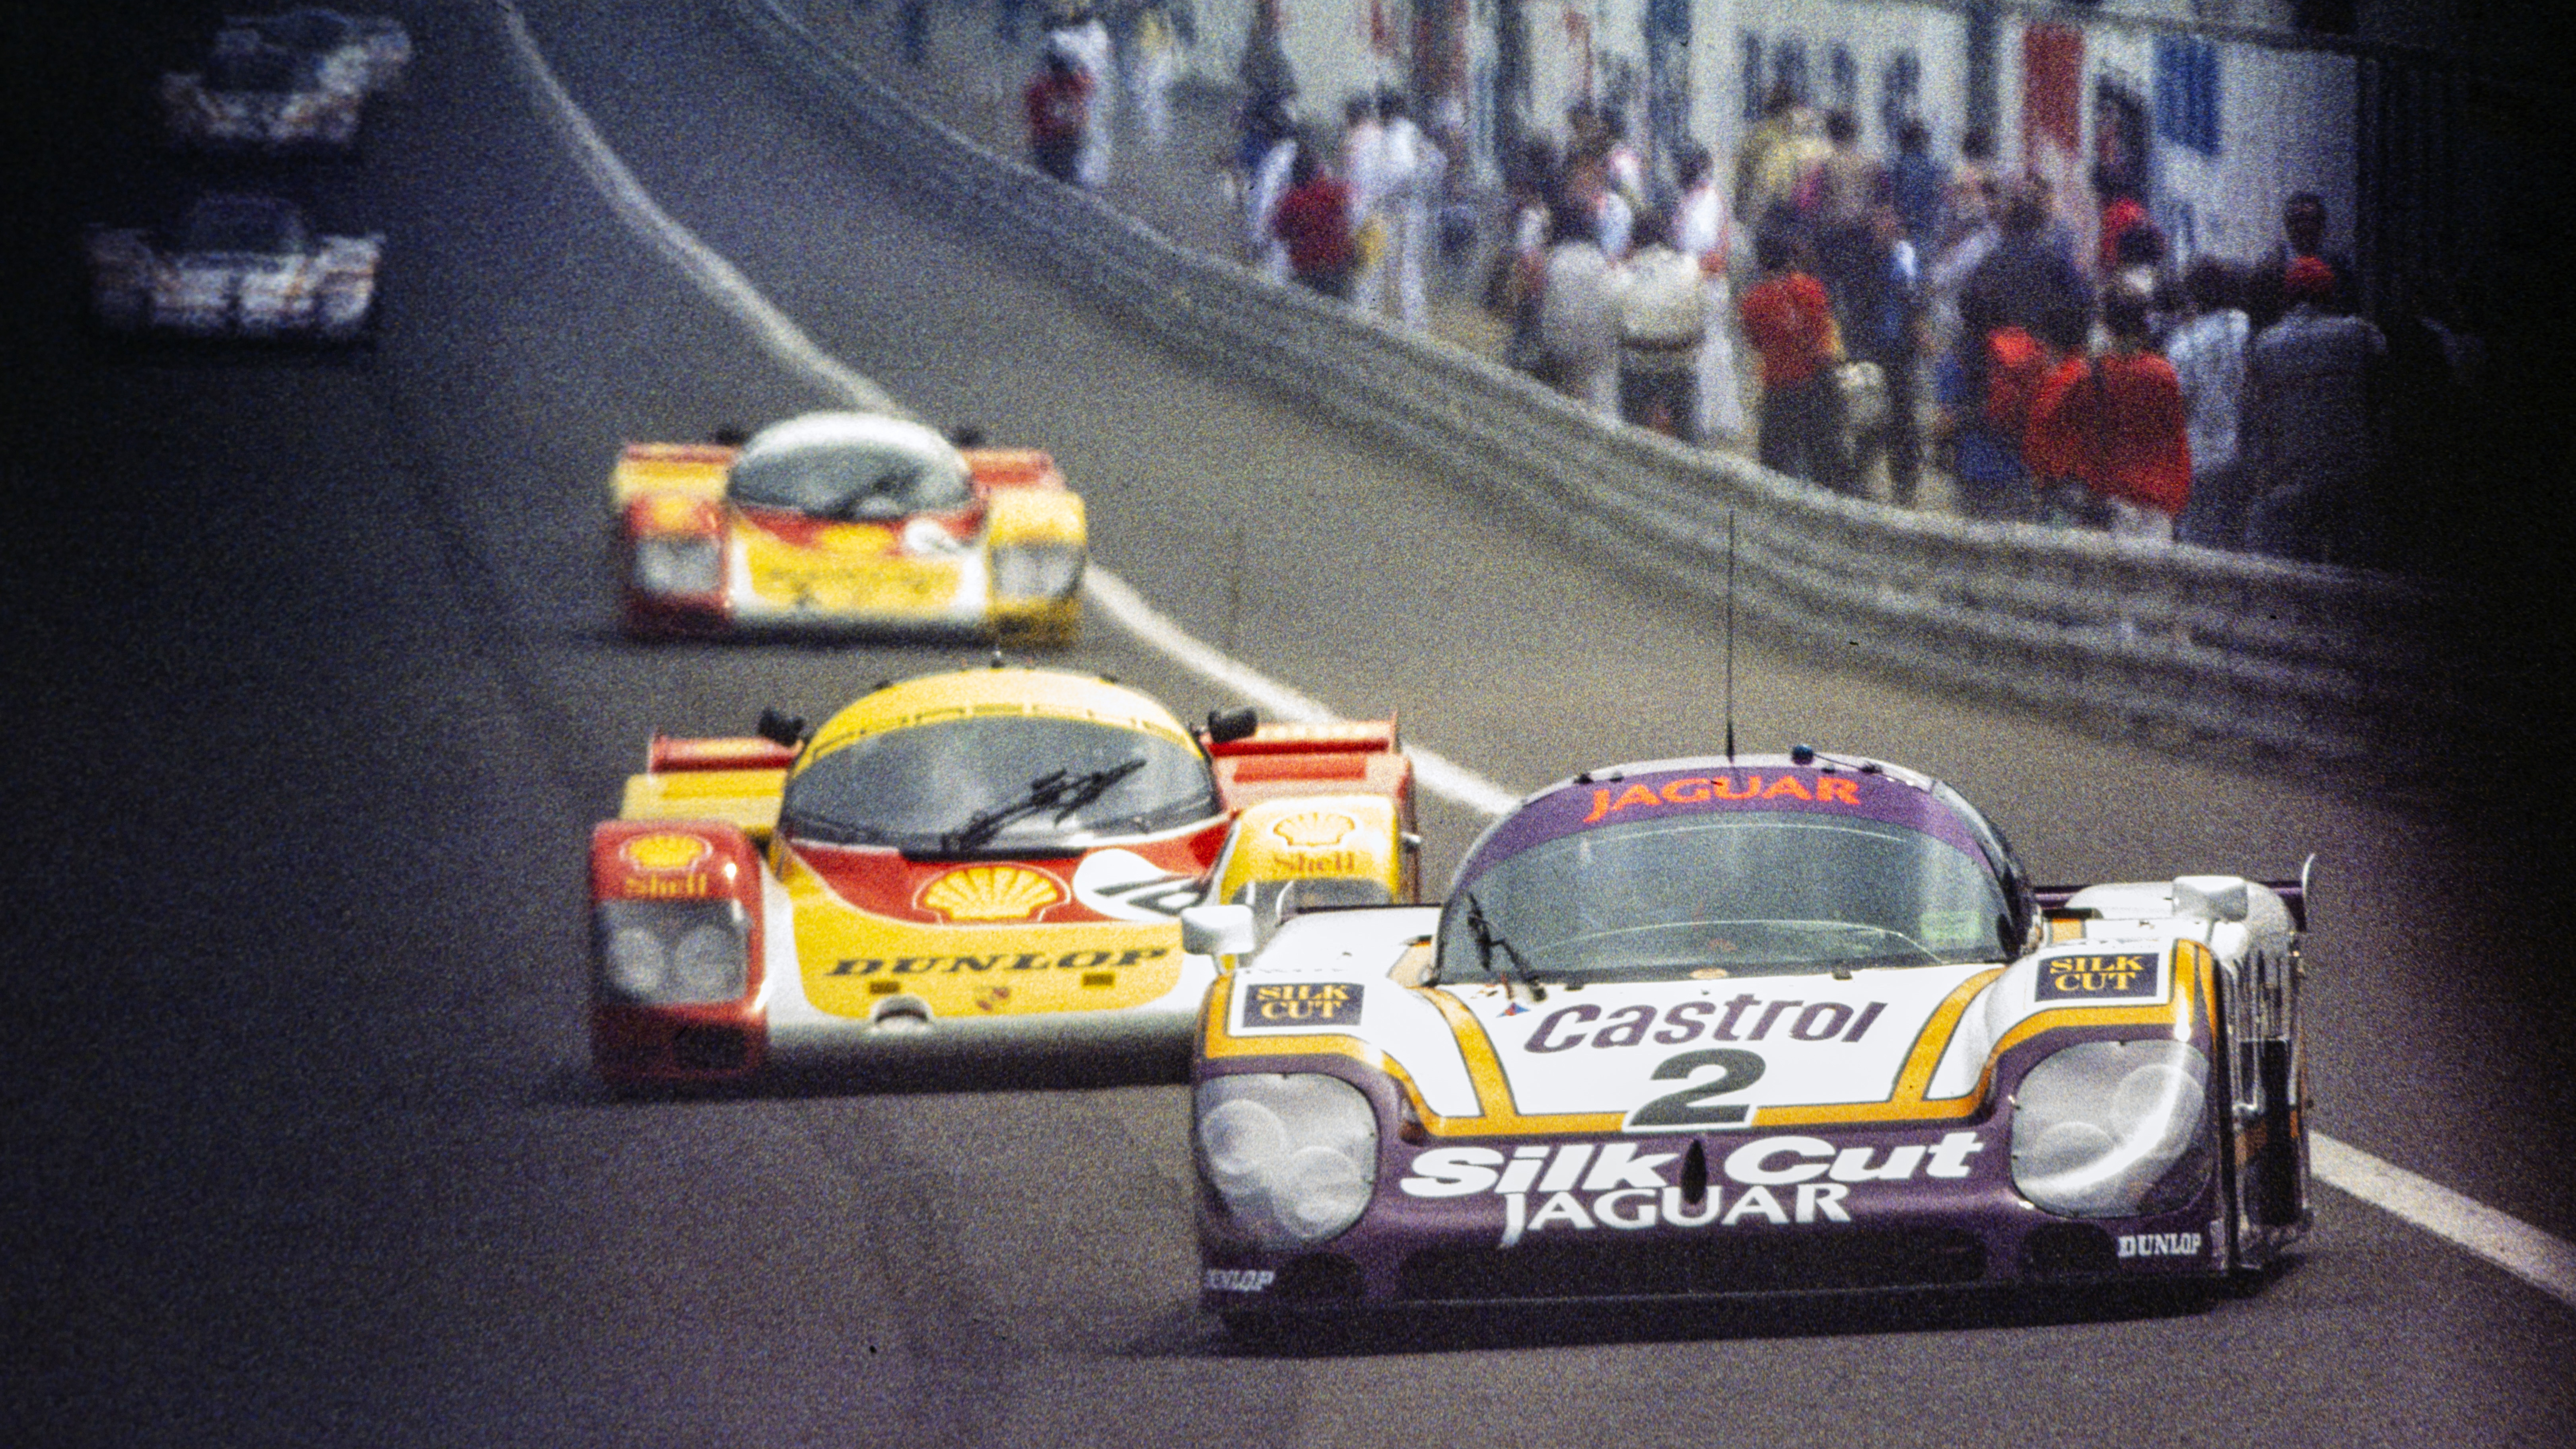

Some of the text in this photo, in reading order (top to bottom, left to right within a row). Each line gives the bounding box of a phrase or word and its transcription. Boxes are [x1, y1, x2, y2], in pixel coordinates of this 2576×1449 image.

[1583, 776, 1860, 823] JAGUAR
[1274, 853, 1354, 873] Shell
[625, 875, 708, 897] Shell
[825, 948, 1168, 976] DUNLOP
[2049, 955, 2144, 974] SILK
[1258, 984, 1349, 1002] SILK
[2055, 972, 2137, 992] CUT
[1260, 1000, 1343, 1019] CUT
[1633, 1049, 1766, 1127] 2
[1401, 1131, 1983, 1197] Silk Cut
[1499, 1183, 1851, 1247] JAGUAR
[2117, 1233, 2202, 1258] DUNLOP
